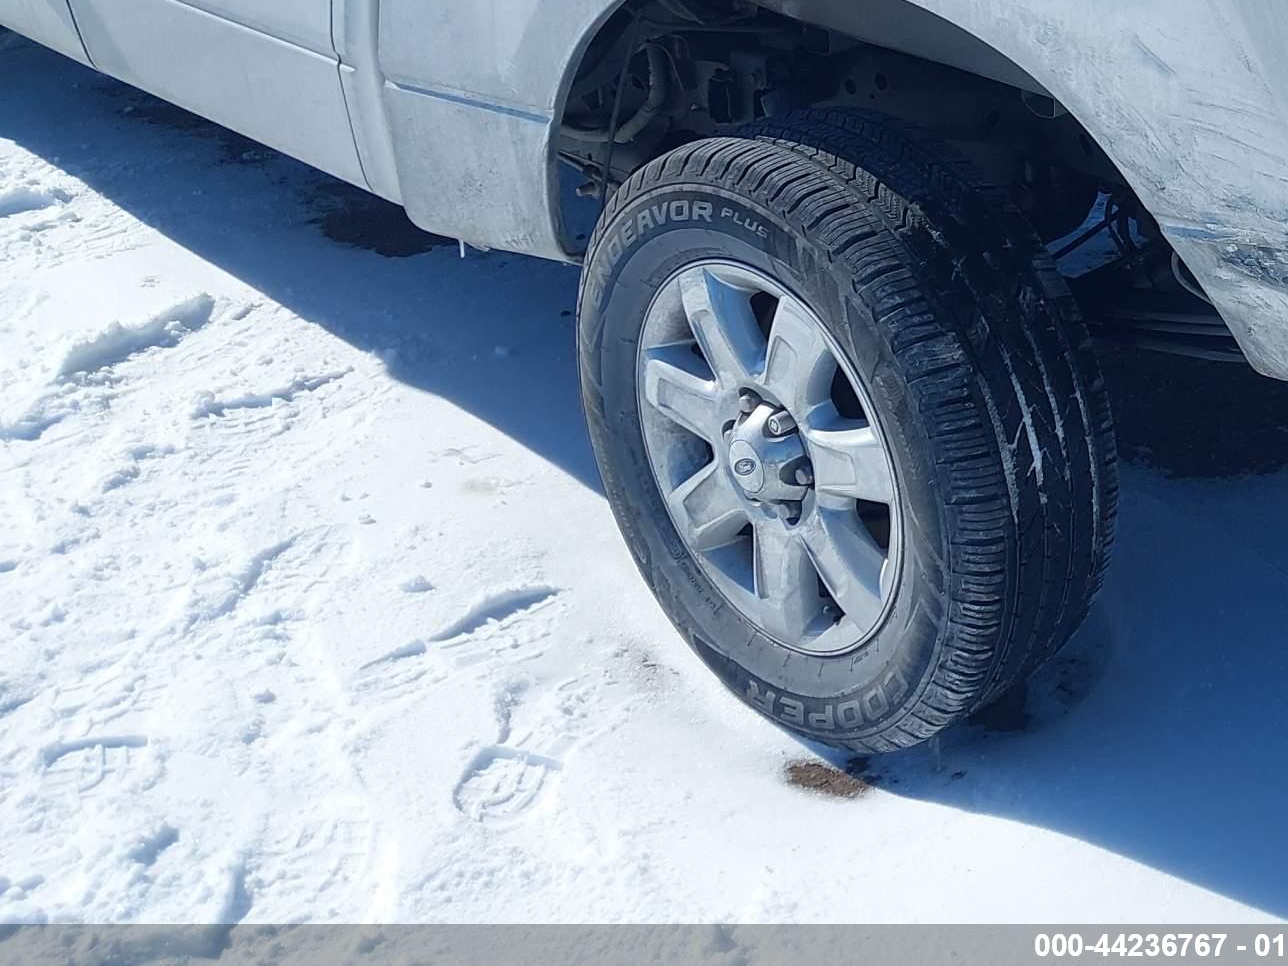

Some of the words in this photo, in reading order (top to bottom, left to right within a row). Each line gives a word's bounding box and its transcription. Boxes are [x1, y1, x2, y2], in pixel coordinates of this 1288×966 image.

[591, 199, 714, 308] ENDEAVOR
[720, 207, 770, 239] PLUS
[745, 670, 910, 731] COOPER
